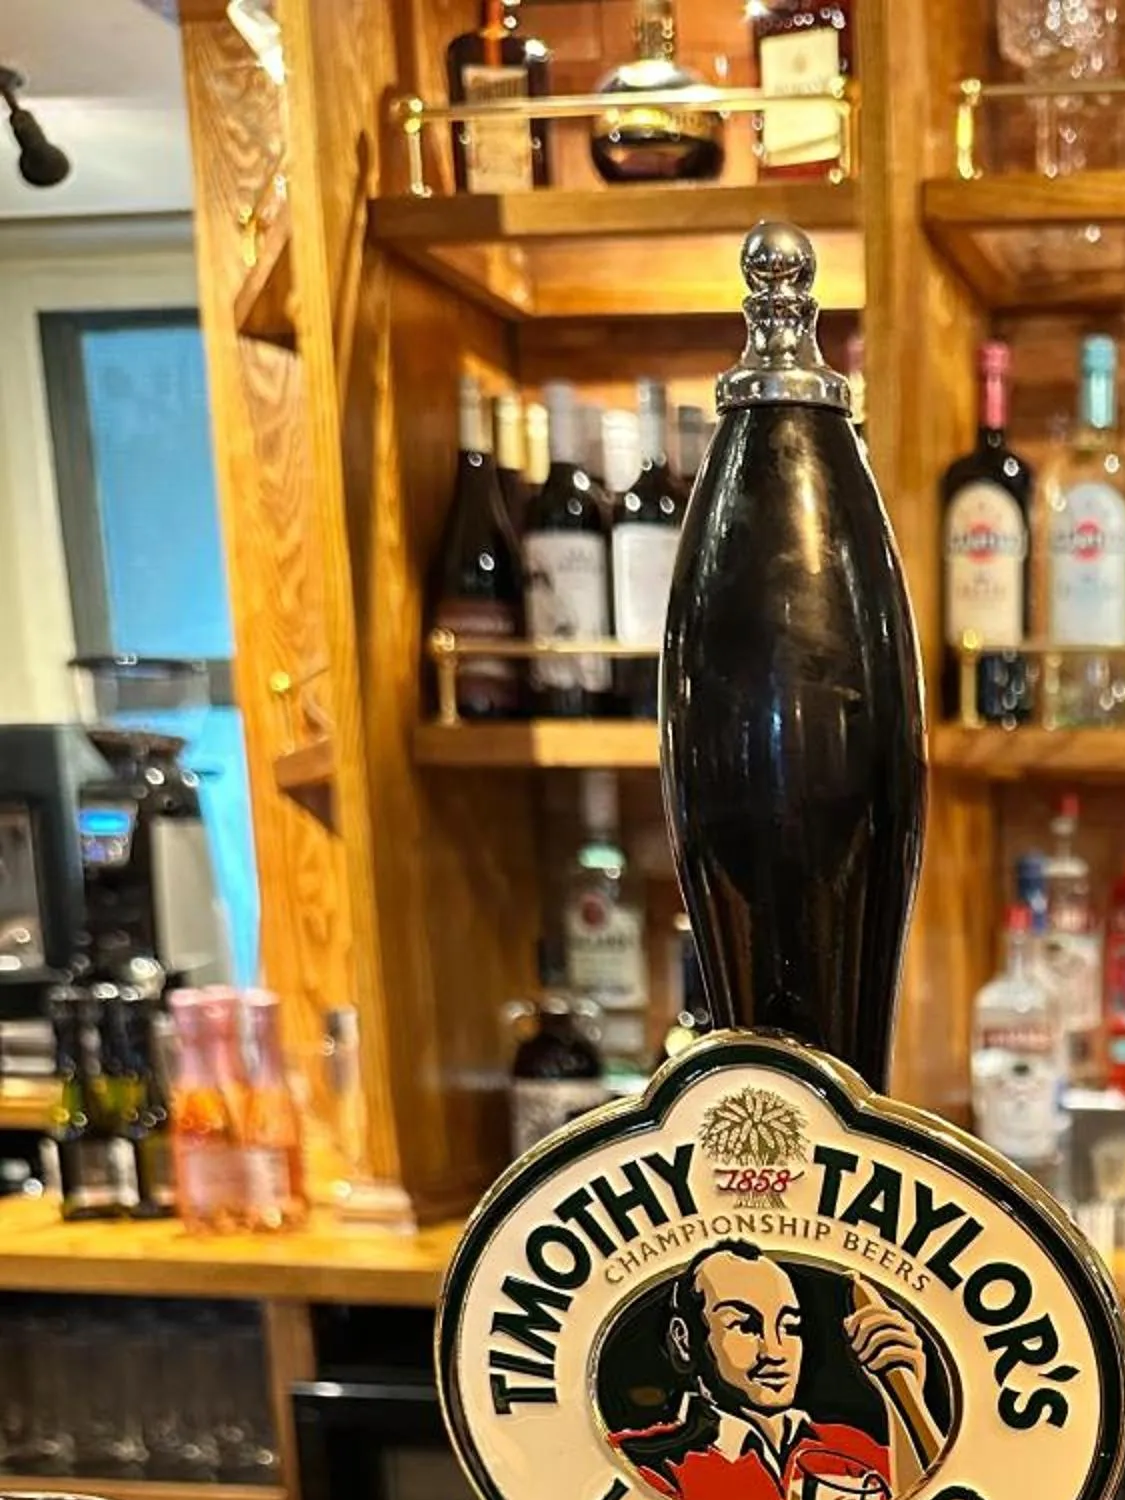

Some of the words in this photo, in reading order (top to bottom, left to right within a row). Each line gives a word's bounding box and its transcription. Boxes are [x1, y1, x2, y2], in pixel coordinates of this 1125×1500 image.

[712, 1166, 804, 1194] 1858
[488, 1143, 699, 1415] TIMOTHY
[813, 1143, 1083, 1433] TAYLOR'S
[604, 1213, 832, 1286] CHAMPIONSHIP
[843, 1229, 933, 1293] BEERS
